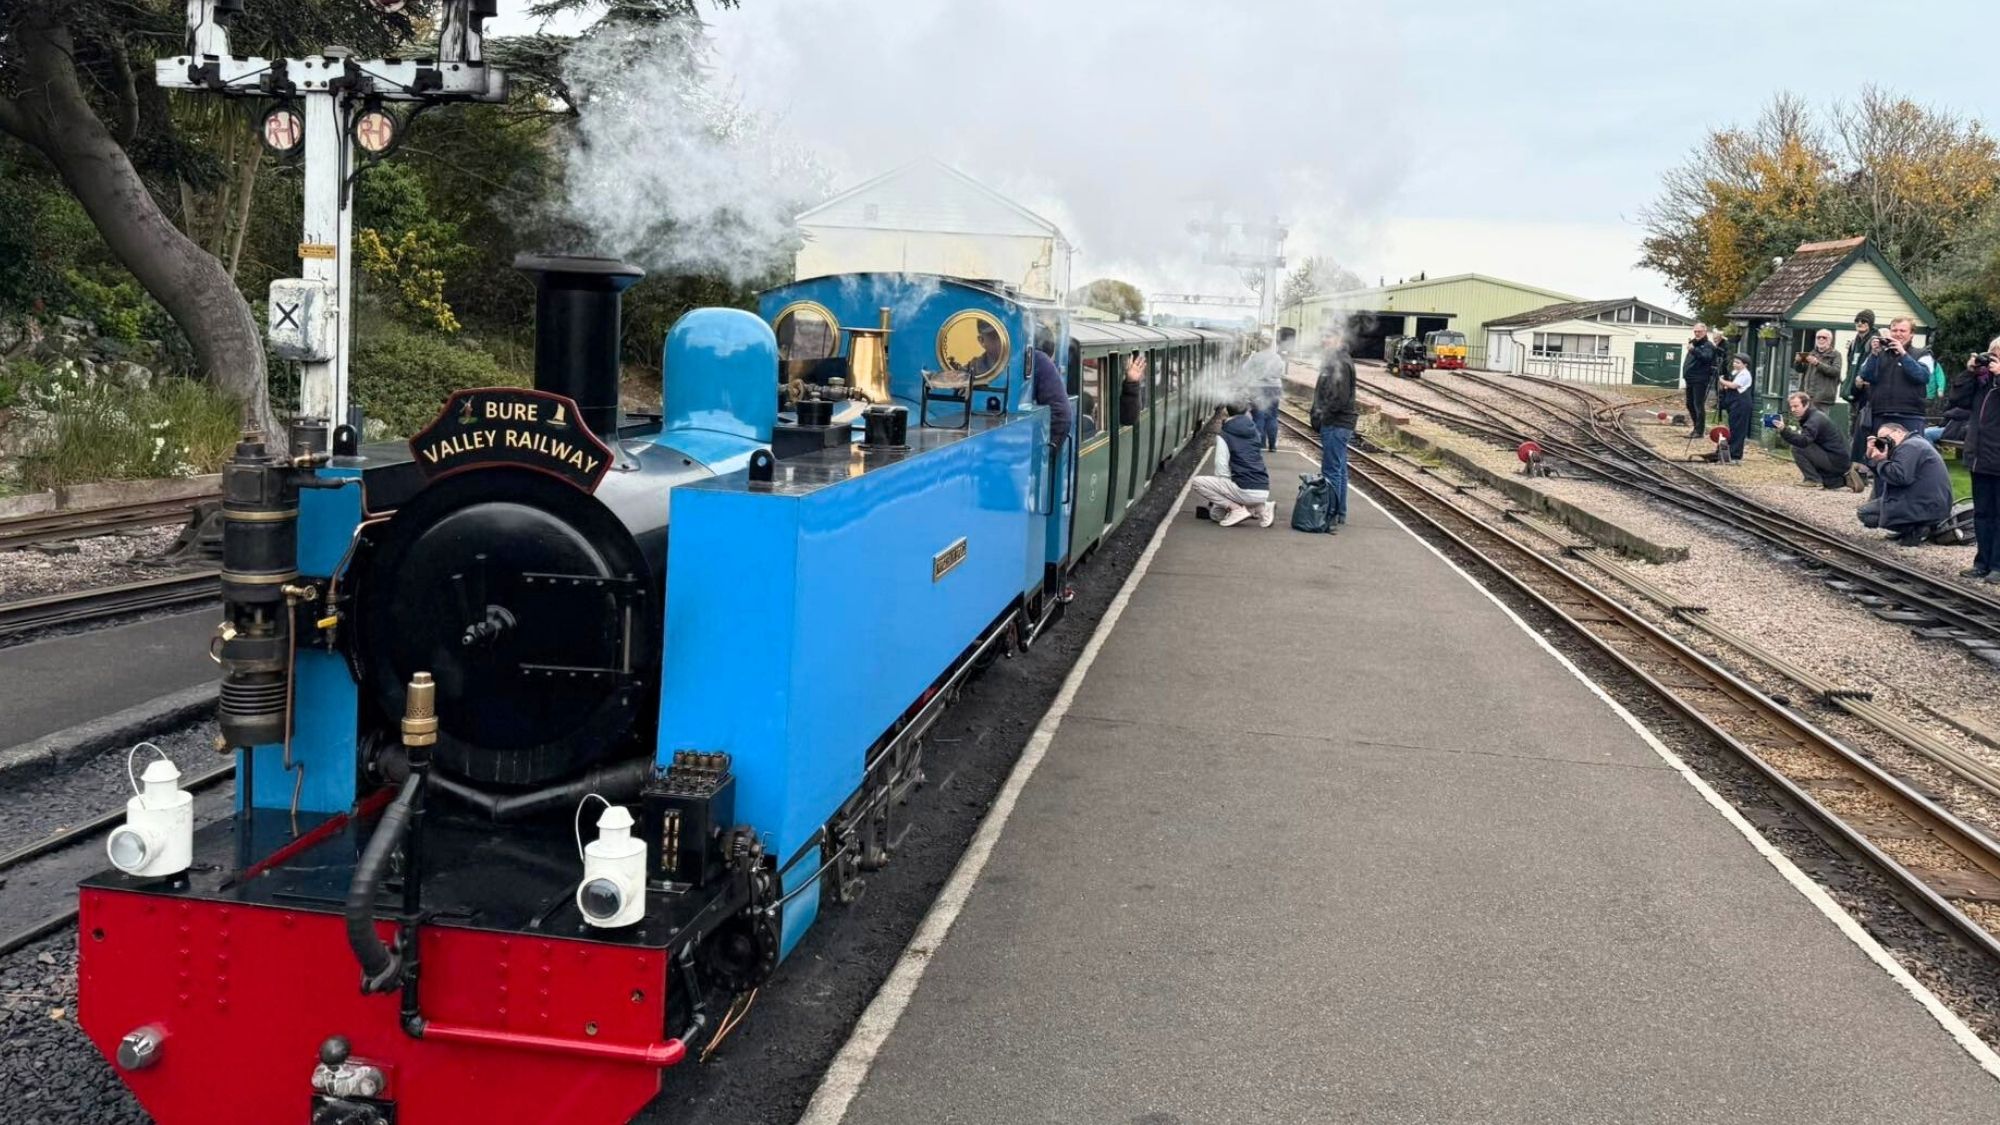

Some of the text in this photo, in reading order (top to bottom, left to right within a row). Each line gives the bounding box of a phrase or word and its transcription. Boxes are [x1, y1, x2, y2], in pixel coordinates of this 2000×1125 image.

[485, 401, 538, 421] BURE
[423, 429, 599, 474] VALLEY RAILWAY
